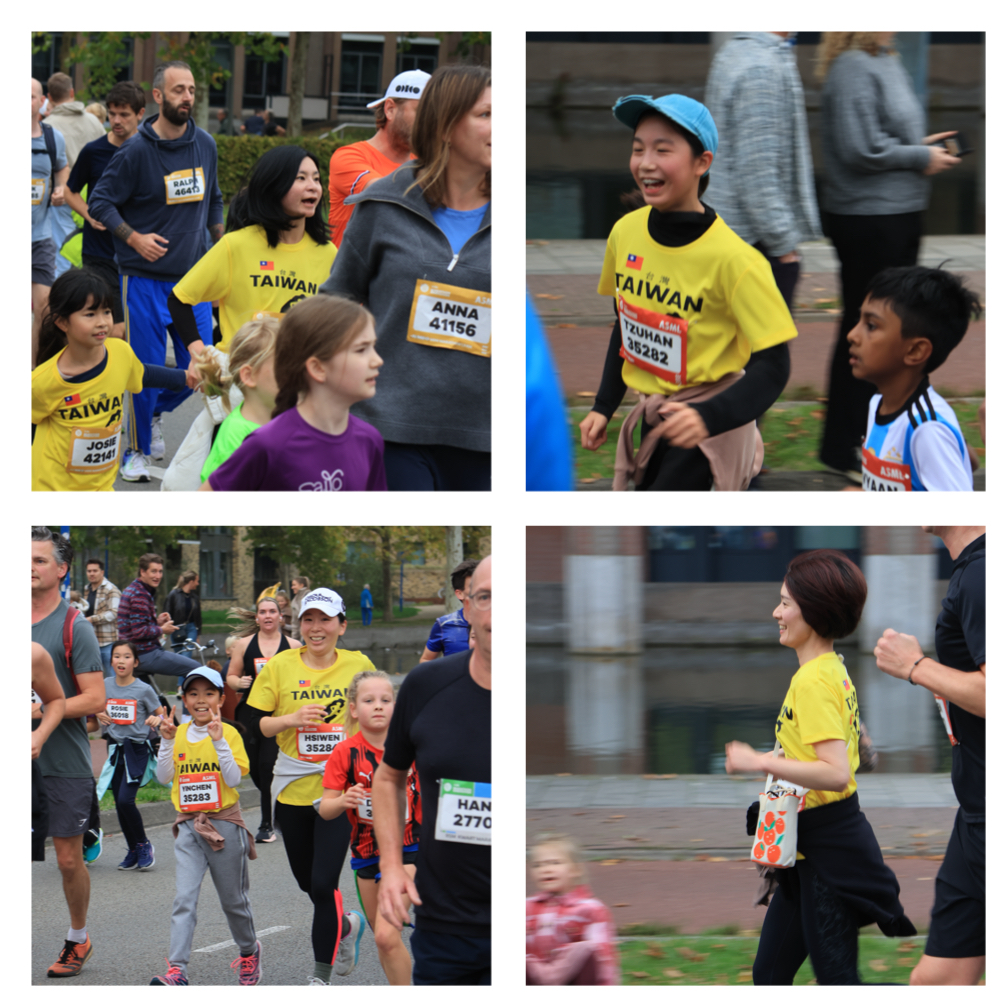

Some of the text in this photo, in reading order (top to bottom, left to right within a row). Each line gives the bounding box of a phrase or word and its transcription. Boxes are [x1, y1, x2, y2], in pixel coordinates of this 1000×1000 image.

[250, 275, 317, 295] TAIWAN
[616, 273, 704, 313] TAIWAN
[432, 301, 479, 320] ANNA
[429, 317, 477, 337] 41156
[623, 319, 673, 349] TZUHAN
[659, 320, 682, 333] ASML
[58, 394, 124, 420] TAIWA
[86, 436, 118, 451] JOSIE
[83, 448, 117, 464] 42141
[303, 734, 341, 745] HSIWEN
[181, 784, 212, 794] YINCHEN
[182, 793, 212, 803] 35283
